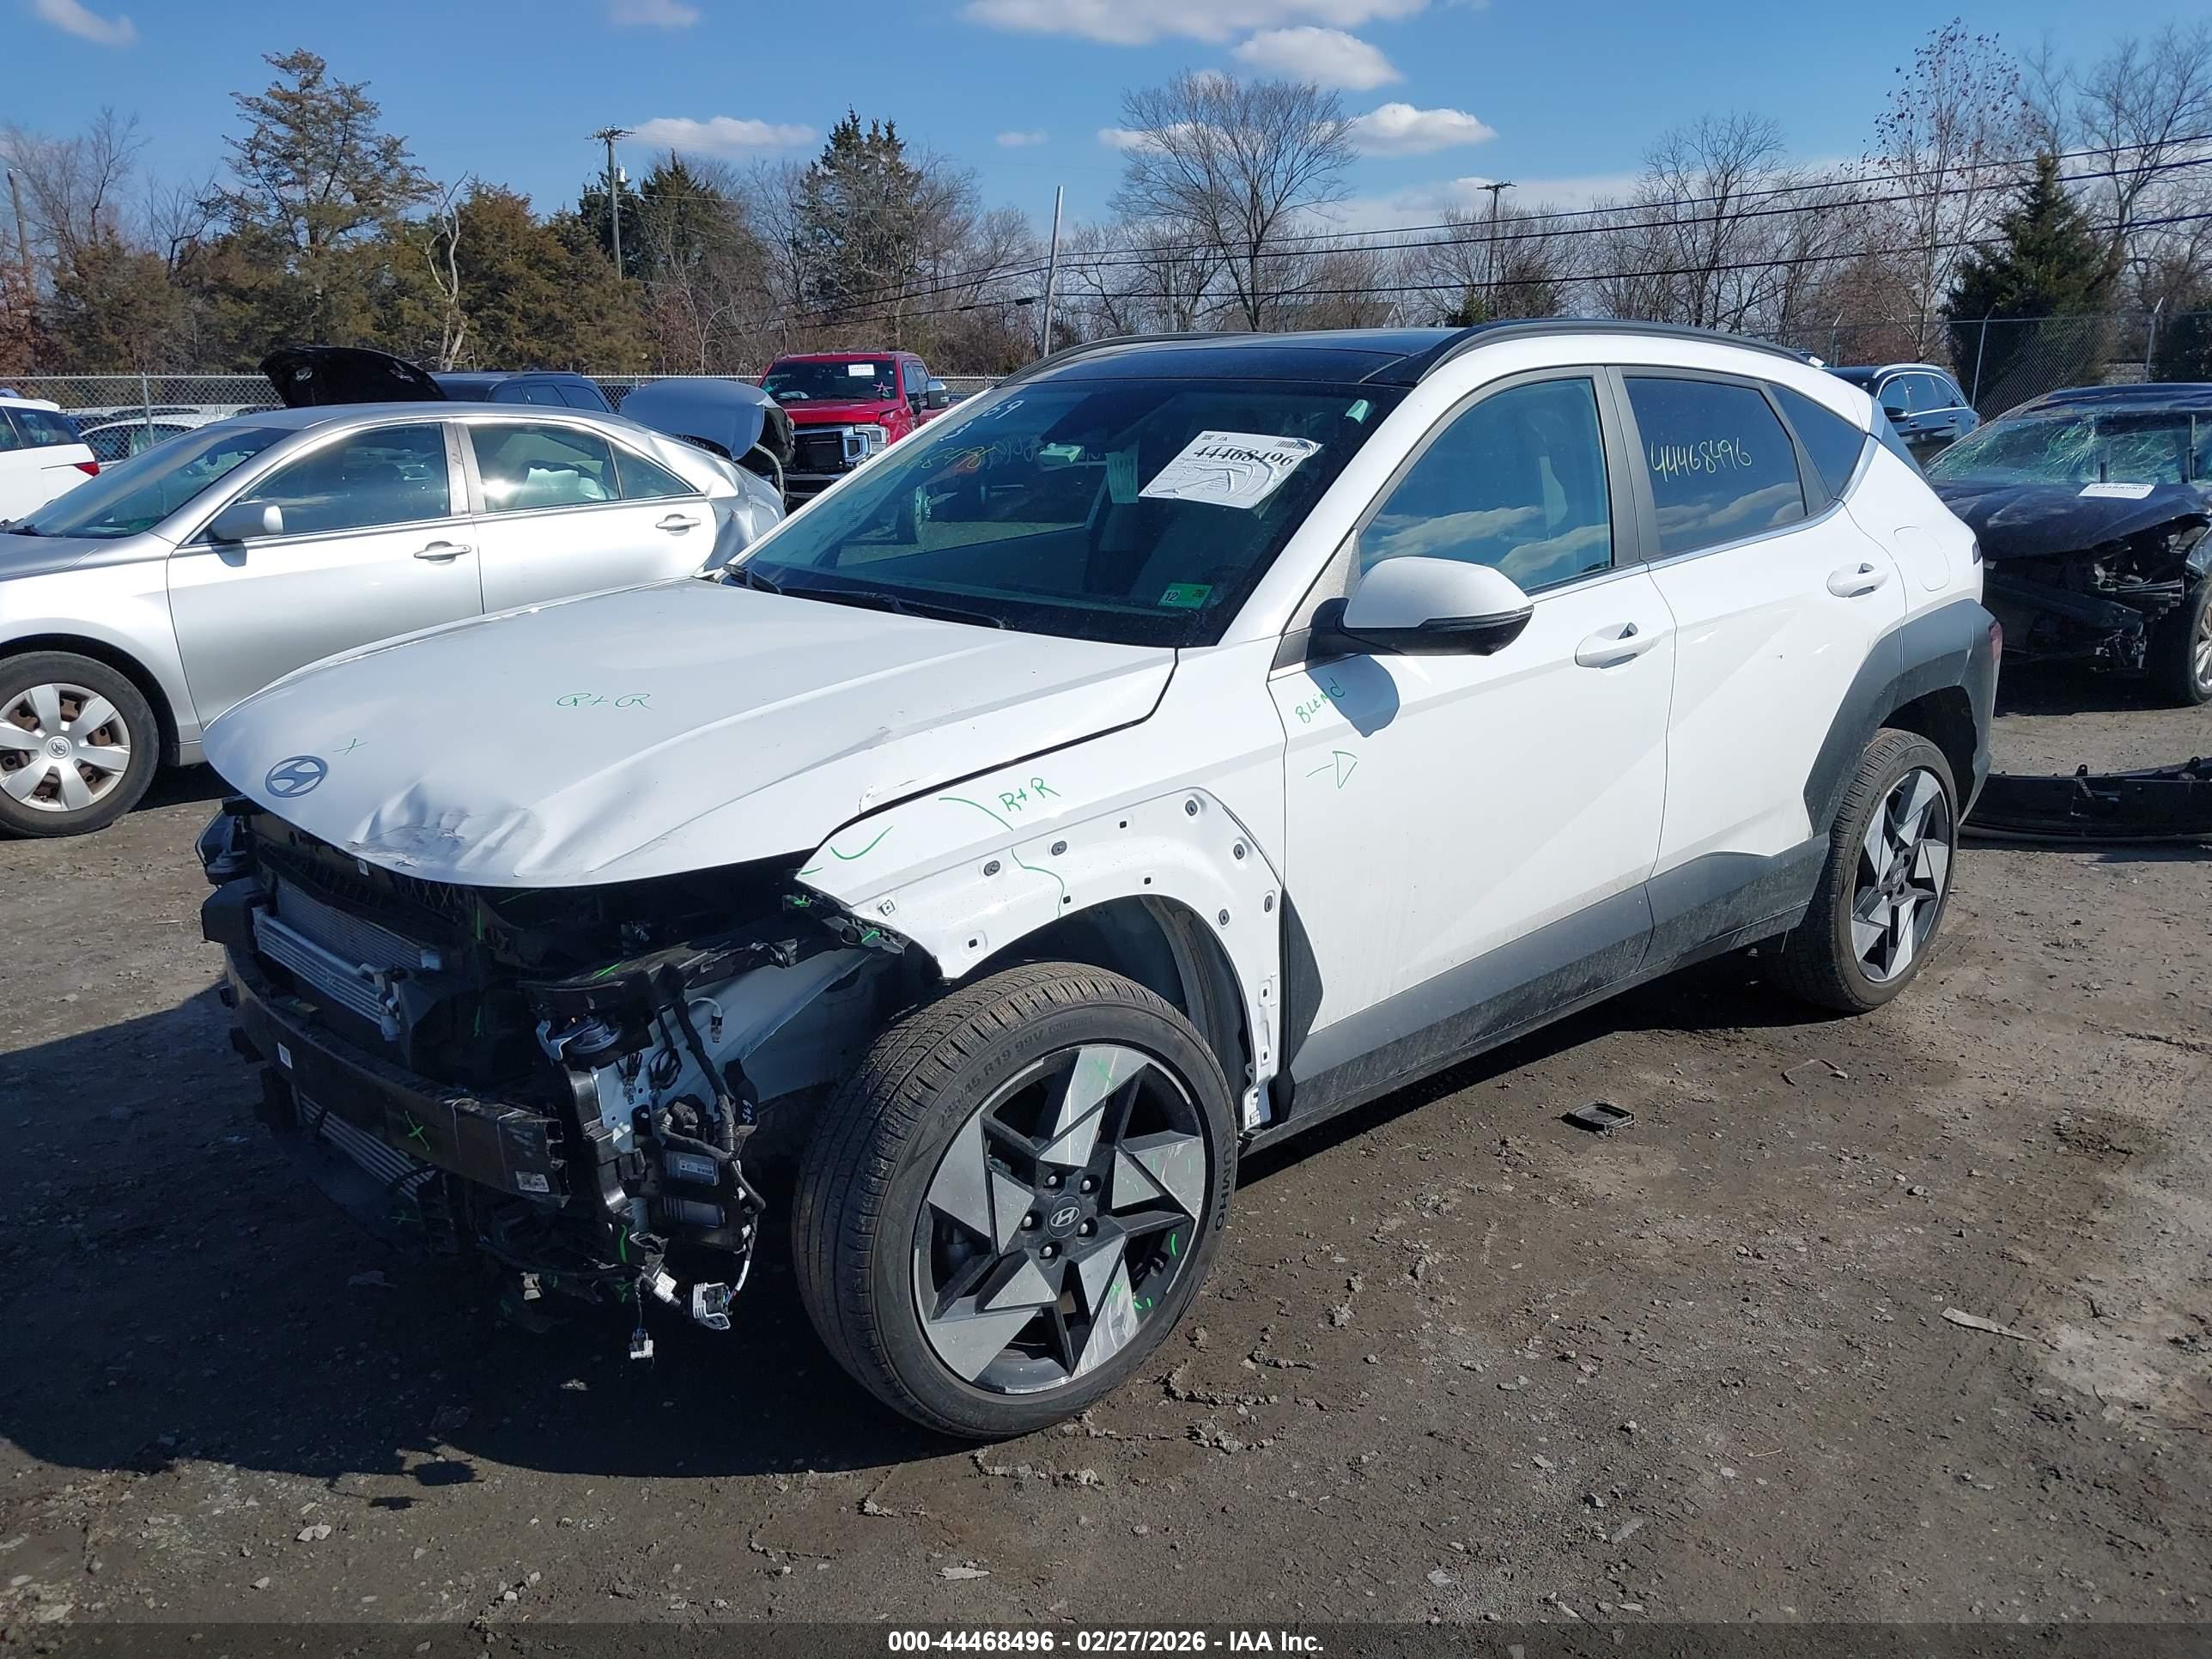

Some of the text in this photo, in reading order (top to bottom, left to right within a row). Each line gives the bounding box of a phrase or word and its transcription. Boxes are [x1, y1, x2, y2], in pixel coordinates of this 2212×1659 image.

[1650, 436, 1752, 483] 44468496
[1164, 591, 1179, 602] 12
[982, 1048, 1012, 1076] R19
[1014, 1029, 1044, 1054] 99V
[1214, 1131, 1233, 1231] KUMHO
